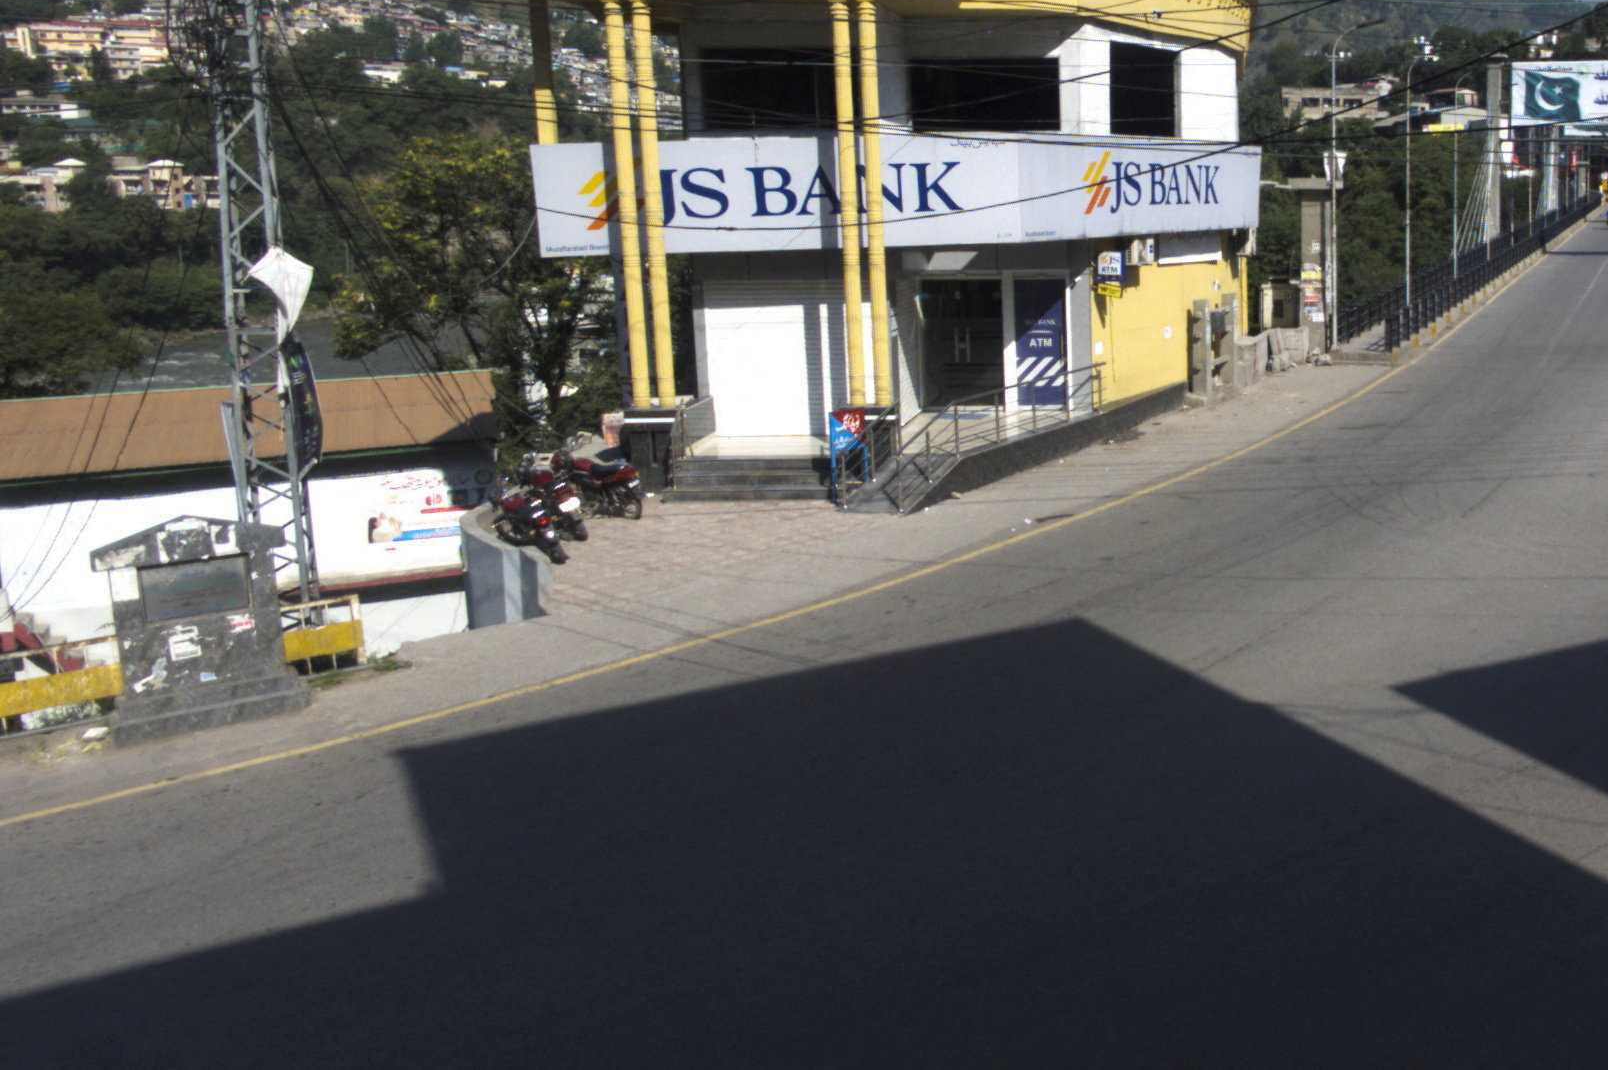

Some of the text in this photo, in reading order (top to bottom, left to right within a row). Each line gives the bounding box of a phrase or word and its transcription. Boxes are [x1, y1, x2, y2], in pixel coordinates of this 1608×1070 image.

[657, 161, 965, 227] JS BANK
[1110, 161, 1220, 214] JS BANK
[1029, 338, 1053, 347] ATM
